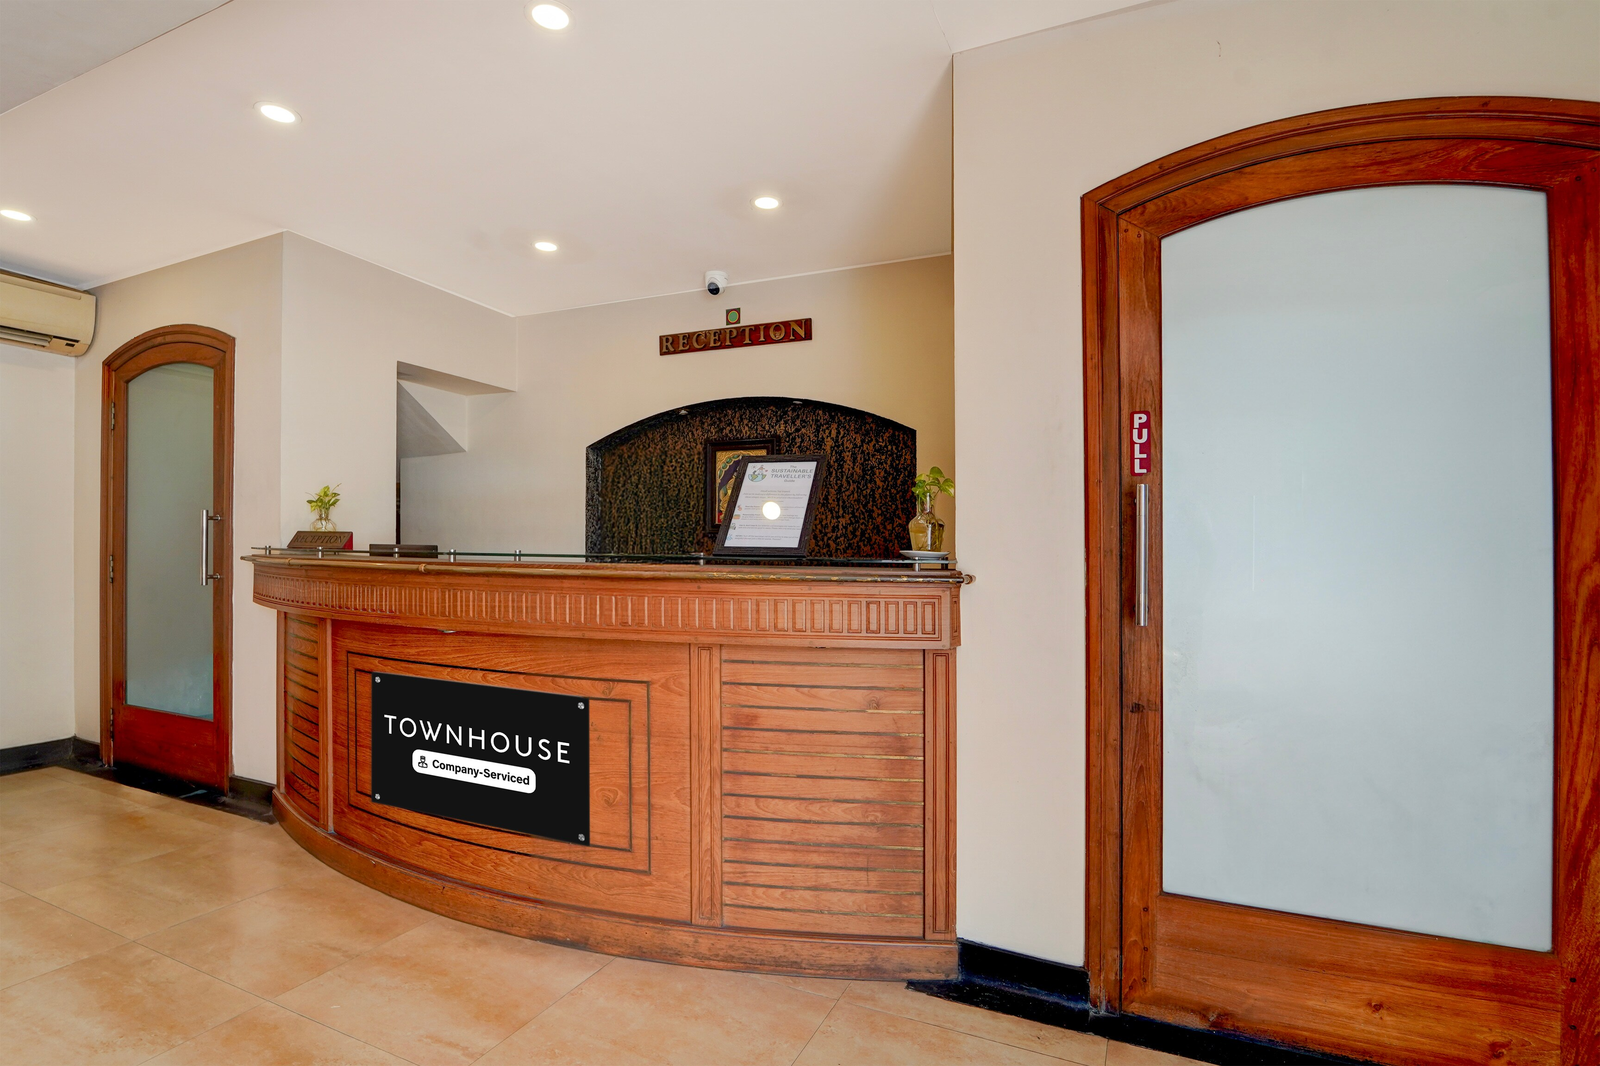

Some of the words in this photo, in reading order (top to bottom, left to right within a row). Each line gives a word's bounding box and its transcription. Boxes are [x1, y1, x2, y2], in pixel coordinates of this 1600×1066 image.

[662, 319, 806, 353] RECEPTION
[1132, 413, 1148, 474] PULL
[293, 535, 346, 544] RECEPTION
[383, 714, 571, 764] TOWNHOUSE
[432, 759, 530, 786] Company-Serviced
